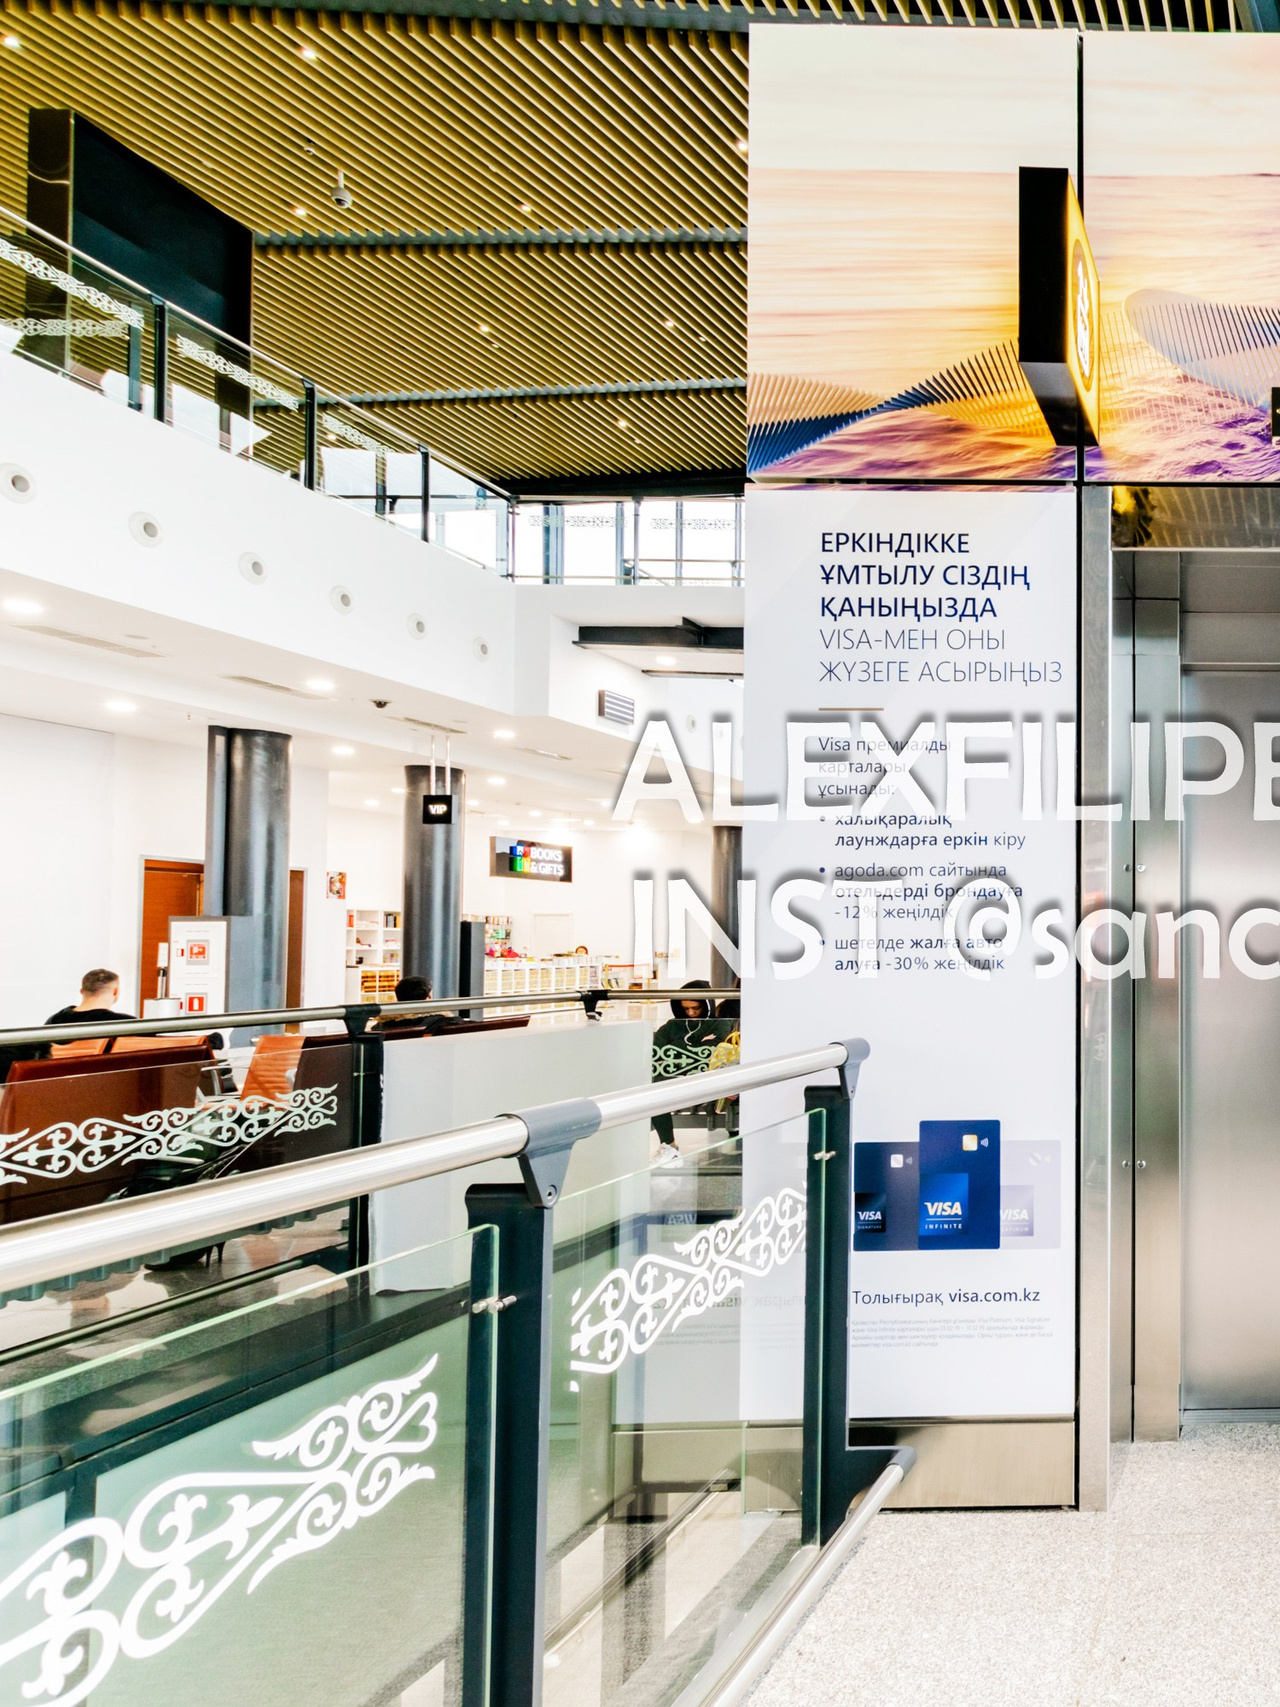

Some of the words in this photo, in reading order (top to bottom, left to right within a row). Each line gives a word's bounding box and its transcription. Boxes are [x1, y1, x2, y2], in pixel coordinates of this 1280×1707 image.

[821, 533, 970, 557] ЕРКІНДІККЕ
[821, 564, 935, 585] ҰМТЫЛУ
[943, 564, 1030, 590] СІЗДІҢ
[821, 596, 998, 622] ҚАНЫҢЫЗДА
[819, 629, 938, 650] VISA-МЕН
[946, 629, 1005, 650] ОНЫ
[819, 661, 910, 682] ЖҮЗЕГЕ
[918, 661, 1063, 687] АСЫРЫҢЫЗ
[818, 737, 850, 752] Visa
[428, 804, 448, 815] VIP
[835, 835, 938, 850] лаунждарға
[943, 833, 988, 848] еркін
[994, 833, 1026, 850] кіру
[530, 847, 563, 861] BOOKS
[530, 862, 538, 873] &
[539, 862, 564, 876] GIFTS
[835, 863, 924, 880] agoda.com
[929, 863, 1007, 879] сайтында
[883, 905, 954, 922] жеңілдік
[835, 938, 905, 952] шетелде
[966, 938, 1004, 949] авто
[934, 957, 1005, 974] жеңілдік
[857, 1211, 882, 1220] VISA
[924, 1202, 962, 1216] VISA
[852, 1290, 944, 1307] Толығырақ
[949, 1288, 1041, 1303] visa.com.kz
